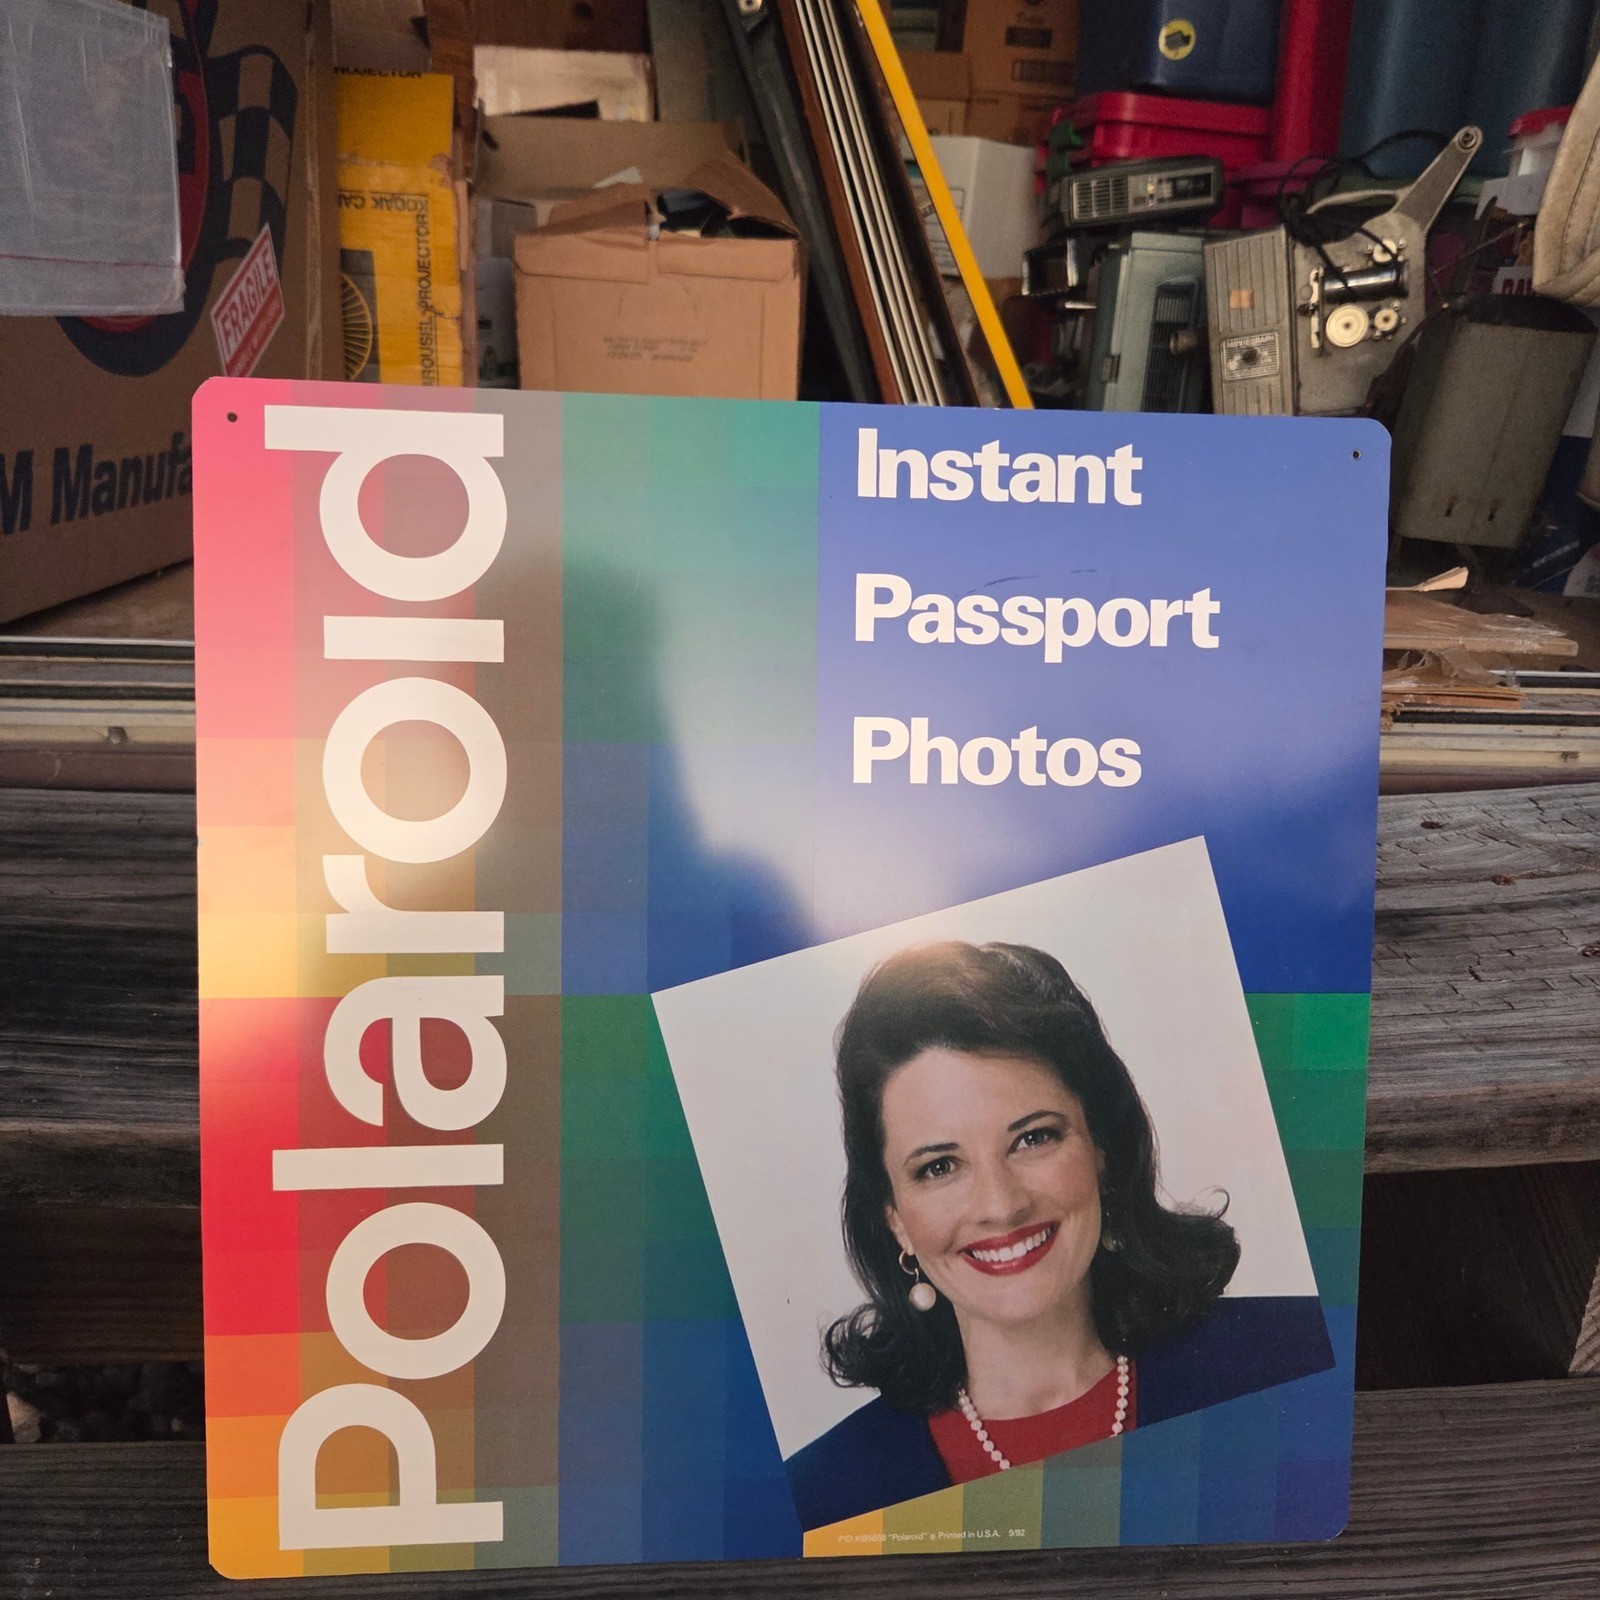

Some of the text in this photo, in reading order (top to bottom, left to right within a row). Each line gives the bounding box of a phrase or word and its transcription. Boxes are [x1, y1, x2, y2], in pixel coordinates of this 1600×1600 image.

[221, 246, 275, 357] FRAGILE
[857, 428, 1143, 506] Instant
[855, 573, 1220, 663] Passport
[853, 716, 1142, 787] Photos
[265, 405, 507, 1550] Polaroid
[938, 1530, 966, 1540] Printed
[967, 1530, 975, 1539] in
[976, 1529, 1001, 1539] U.S.A.
[1008, 1528, 1026, 1537] 9/92
